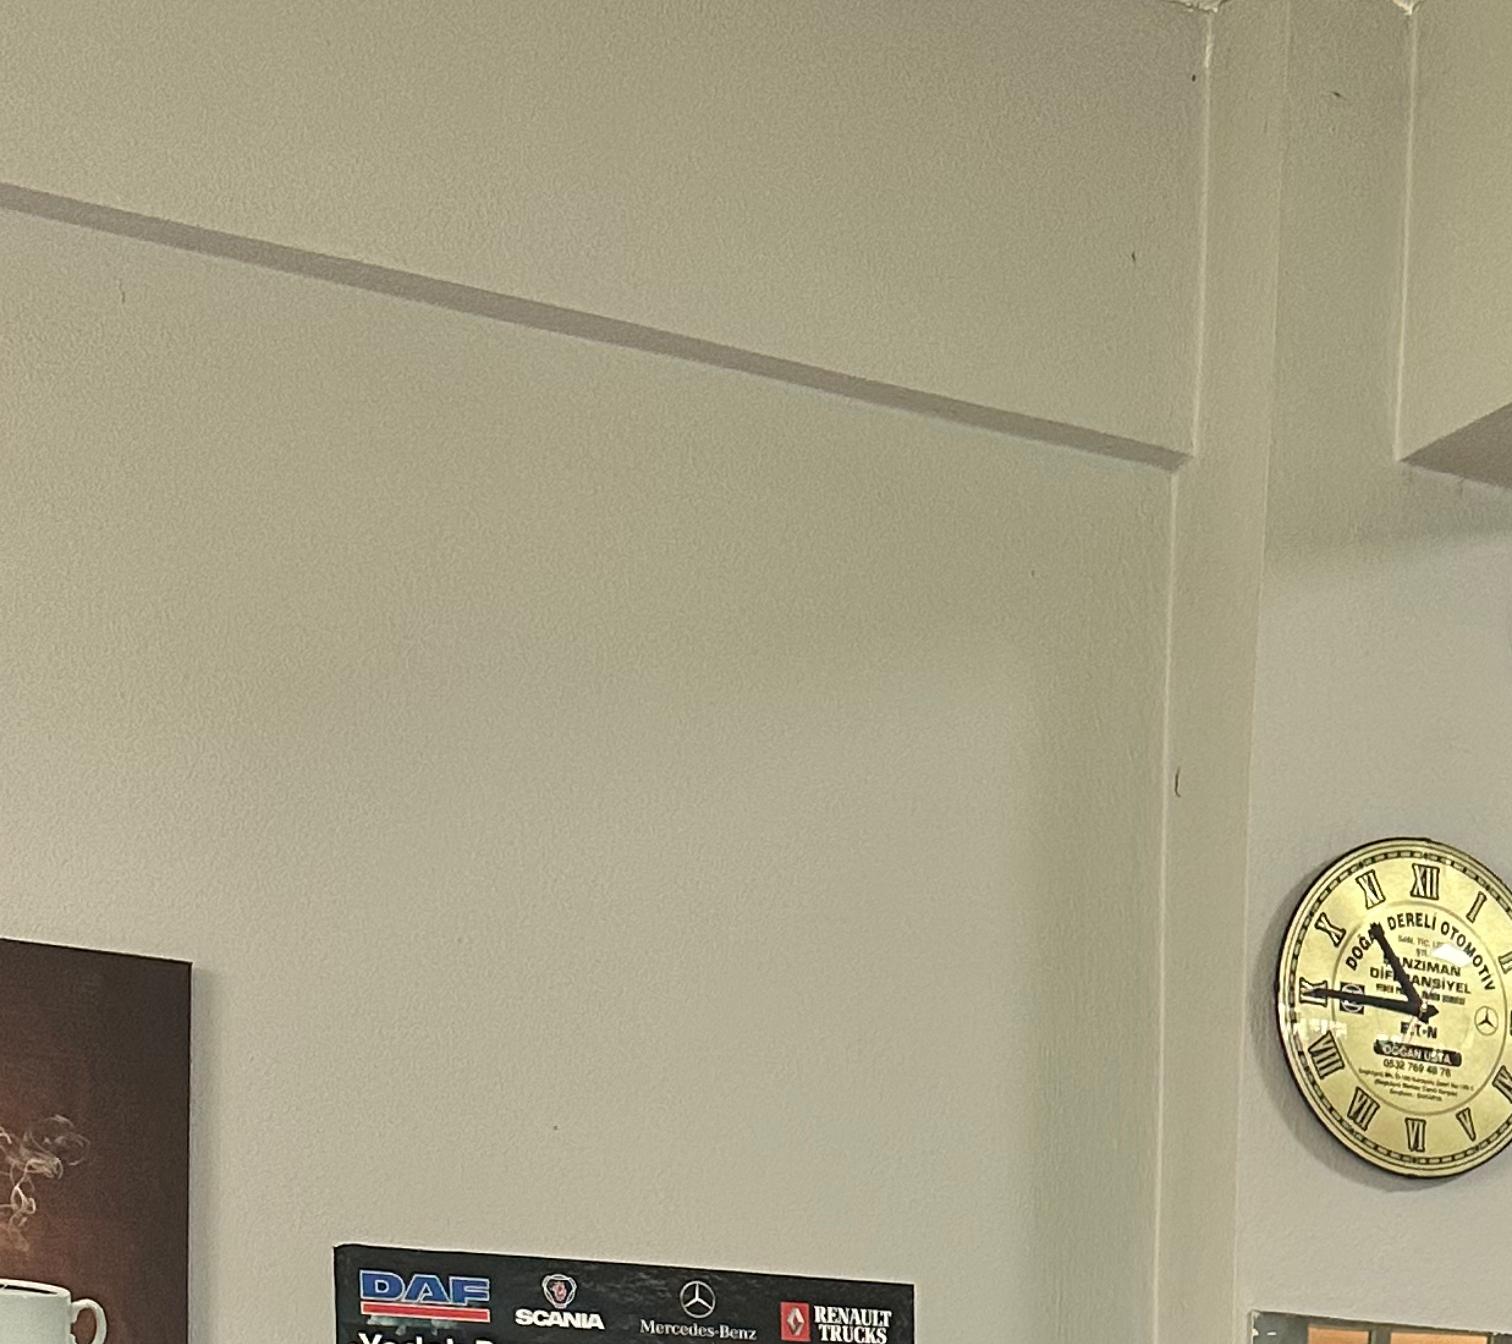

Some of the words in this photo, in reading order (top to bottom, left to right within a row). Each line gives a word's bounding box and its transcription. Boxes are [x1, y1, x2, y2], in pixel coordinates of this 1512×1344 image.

[1356, 869, 1386, 909] XI
[1411, 864, 1440, 900] XII
[1387, 912, 1437, 931] DERELİ
[1466, 891, 1487, 923] I
[1315, 912, 1346, 947] X
[1384, 956, 1461, 977] NZIMAN
[1308, 1030, 1345, 1079] VIII
[1347, 1086, 1381, 1131] VII
[1456, 1107, 1476, 1141] V
[1405, 1117, 1426, 1152] VI
[360, 1270, 490, 1306] DAF
[515, 1308, 605, 1330] SCANIA
[640, 1319, 757, 1341] Mercedes-Benz
[814, 1305, 892, 1328] RENAULT
[818, 1324, 888, 1344] TRUCKS
